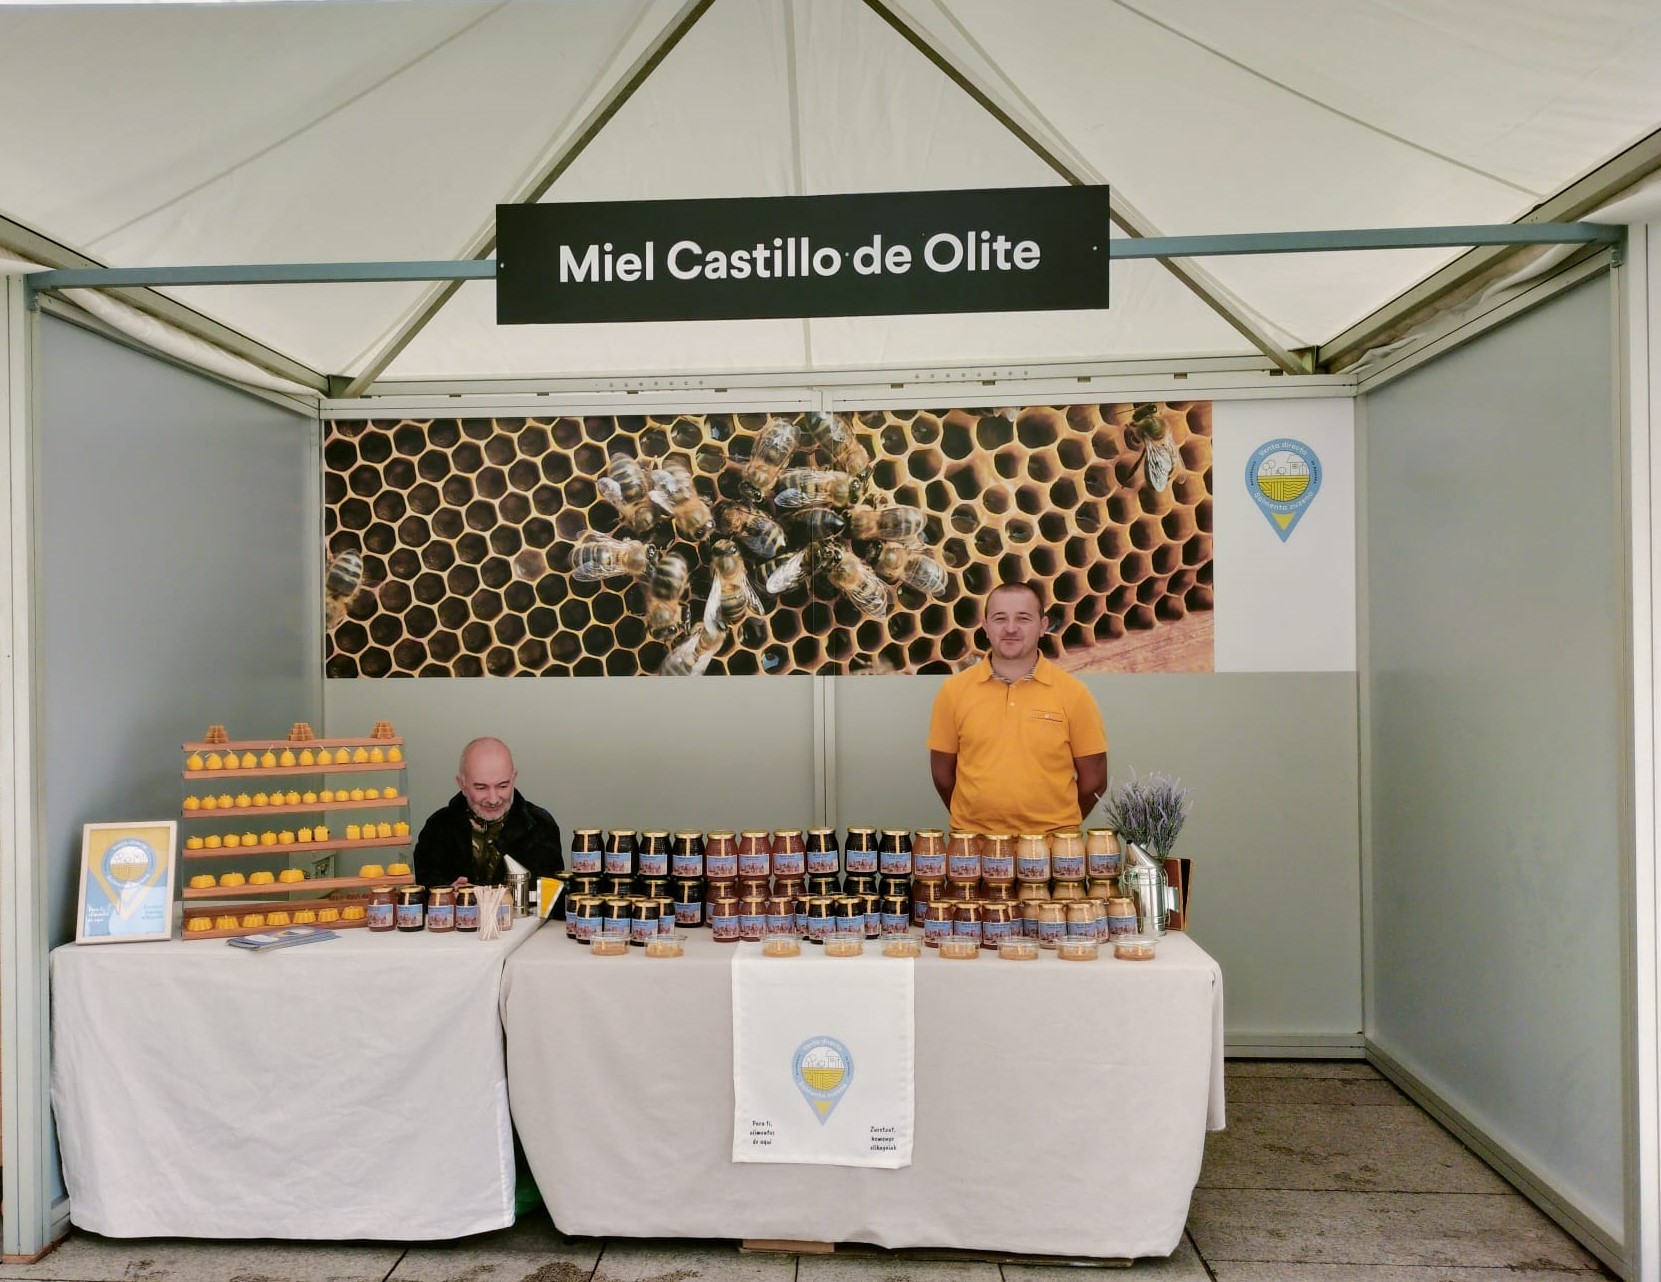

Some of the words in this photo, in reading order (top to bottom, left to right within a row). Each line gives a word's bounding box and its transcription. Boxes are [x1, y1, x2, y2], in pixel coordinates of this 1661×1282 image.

[559, 241, 654, 283] Miel
[666, 236, 842, 280] Castillo
[852, 234, 912, 276] de
[923, 230, 1041, 273] Olite
